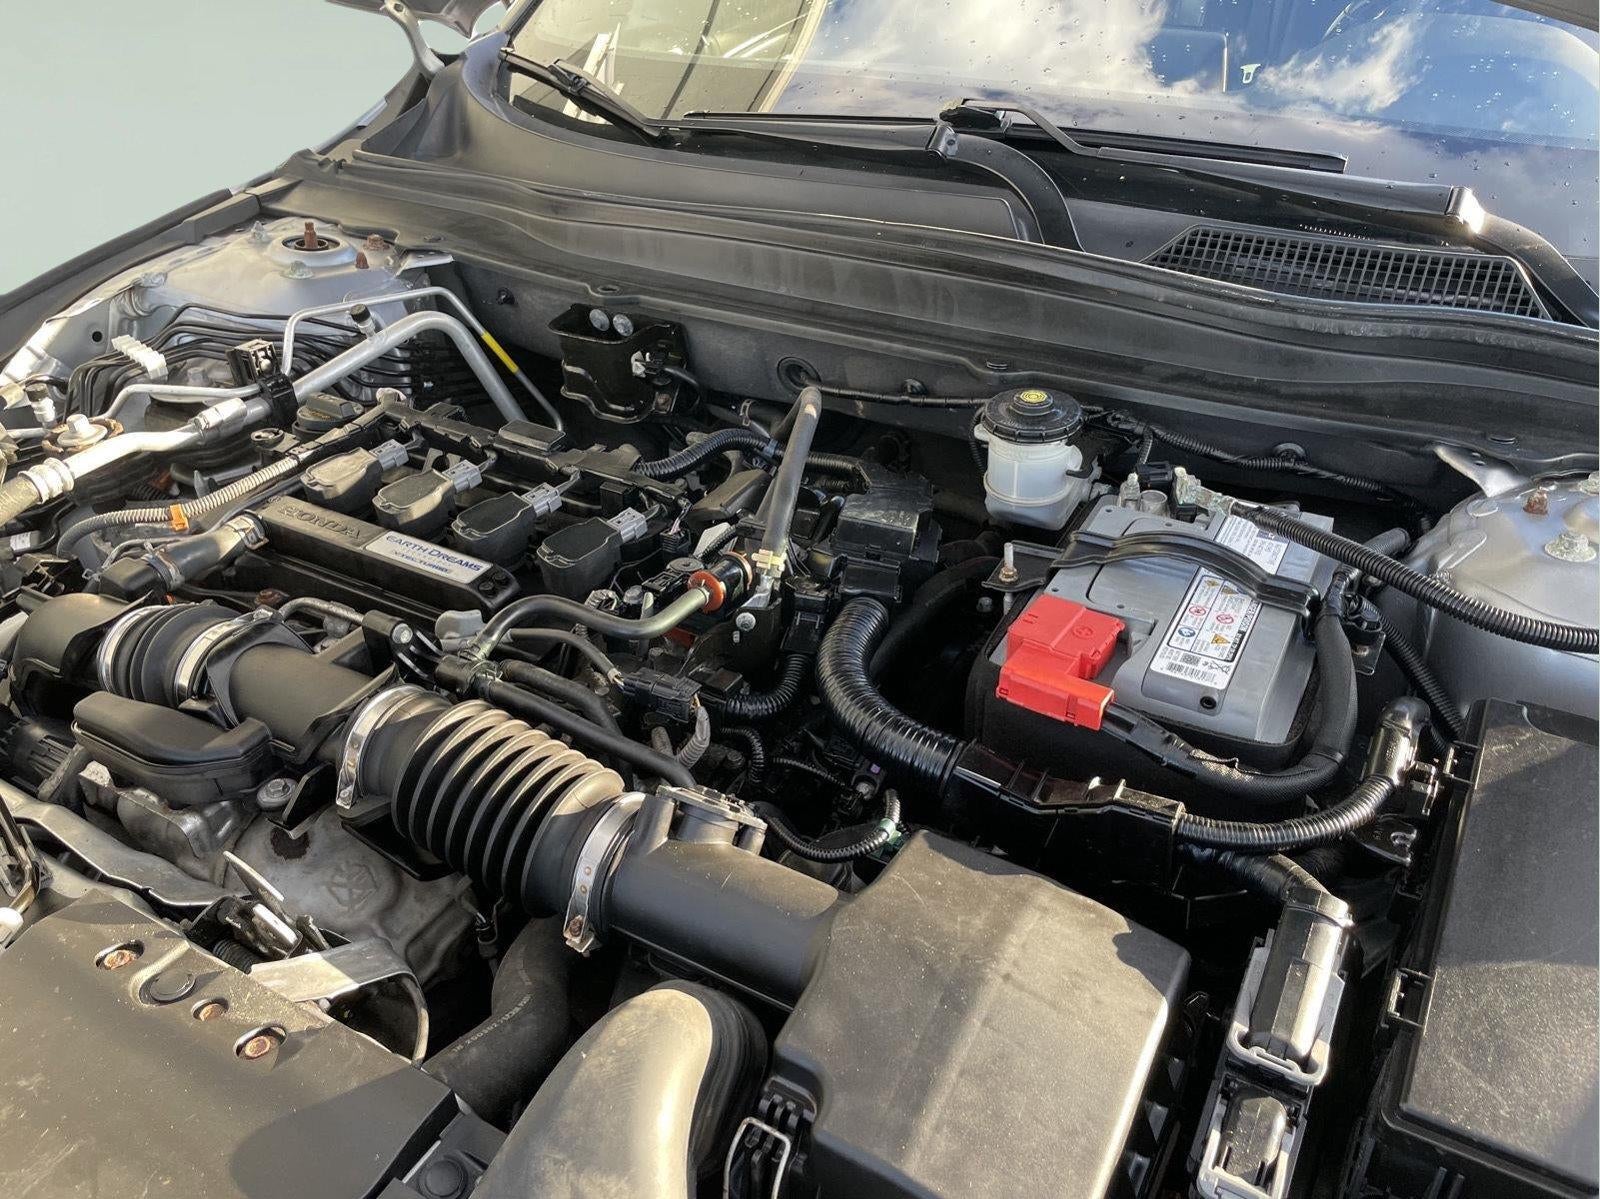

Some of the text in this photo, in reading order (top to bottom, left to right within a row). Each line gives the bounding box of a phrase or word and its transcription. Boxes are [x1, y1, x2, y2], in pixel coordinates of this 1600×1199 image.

[278, 504, 360, 540] HONDA
[386, 535, 429, 554] EARTH
[427, 548, 483, 572] DREAMS
